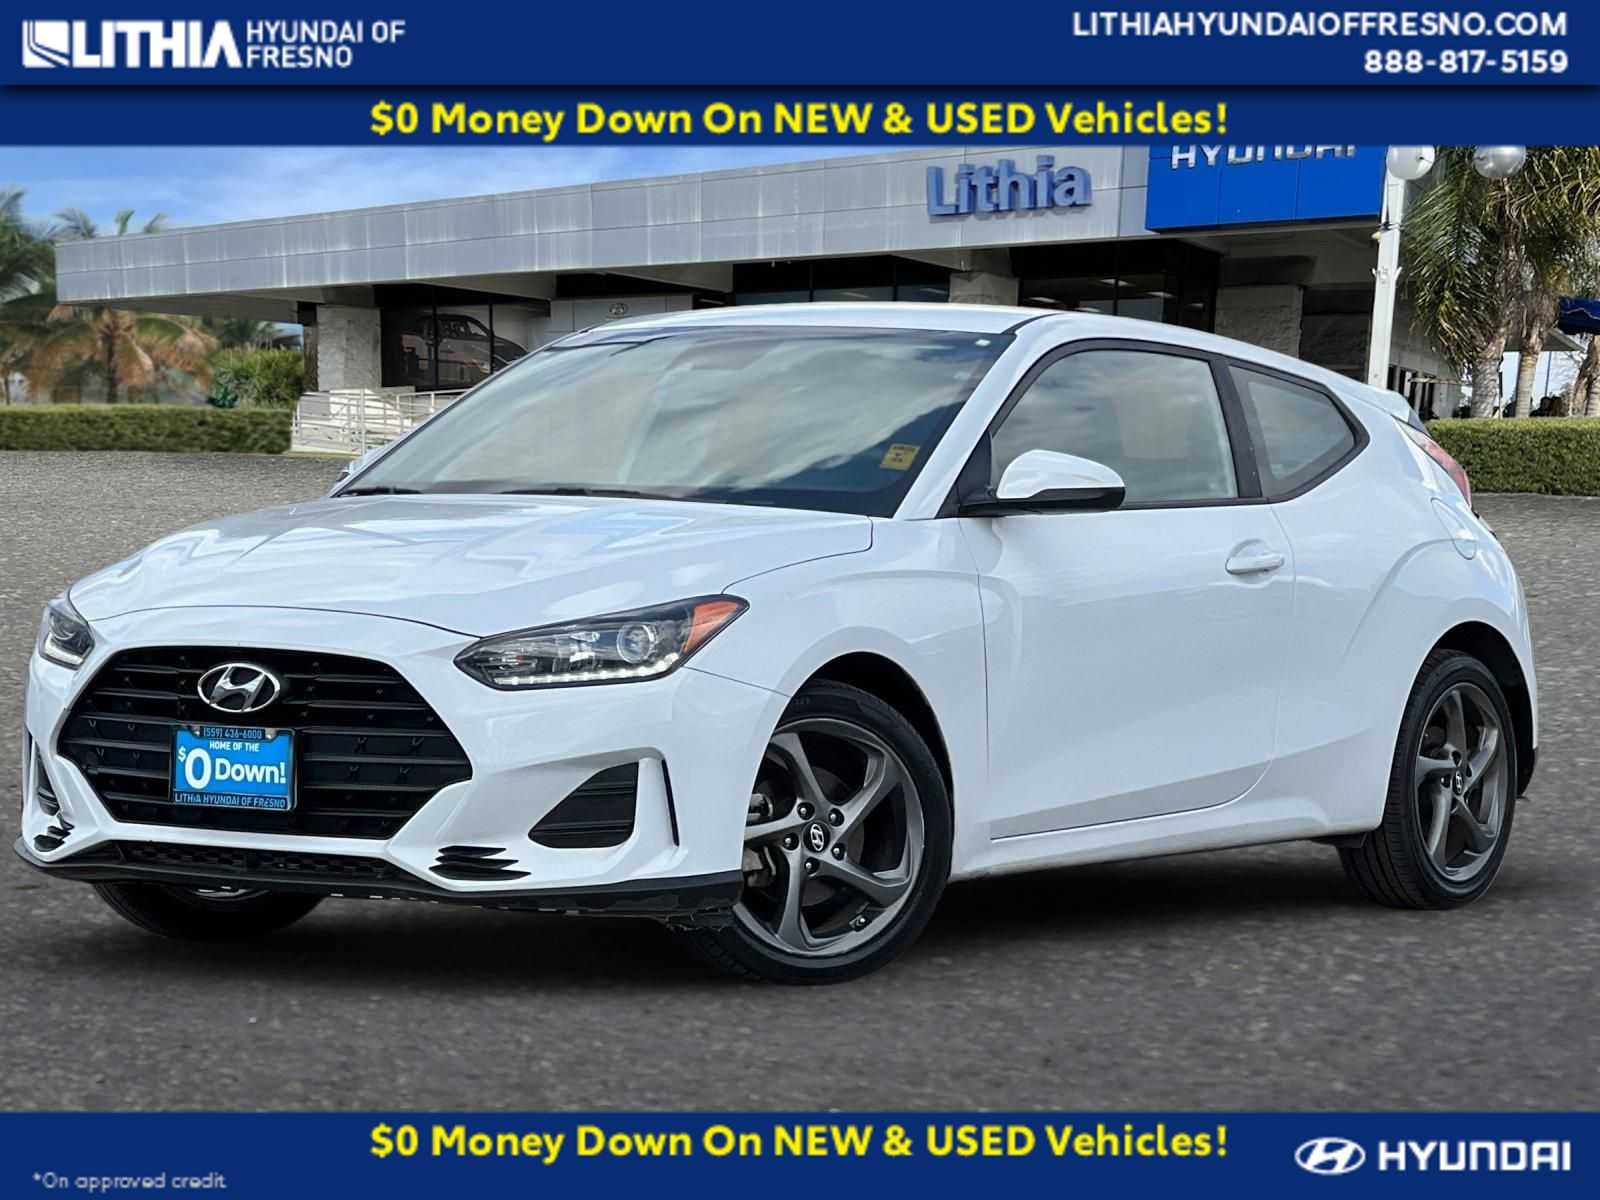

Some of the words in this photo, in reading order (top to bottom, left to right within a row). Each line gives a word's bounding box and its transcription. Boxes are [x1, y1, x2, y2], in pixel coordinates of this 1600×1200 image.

[926, 154, 1093, 217] Lithia
[224, 728, 263, 740] 436-6000
[209, 740, 231, 751] HOME
[232, 741, 243, 752] OF
[244, 742, 260, 753] THE
[215, 757, 287, 785] Down!
[203, 793, 240, 806] HYUNDAI
[241, 795, 252, 806] OF
[253, 796, 286, 808] FRESNO
